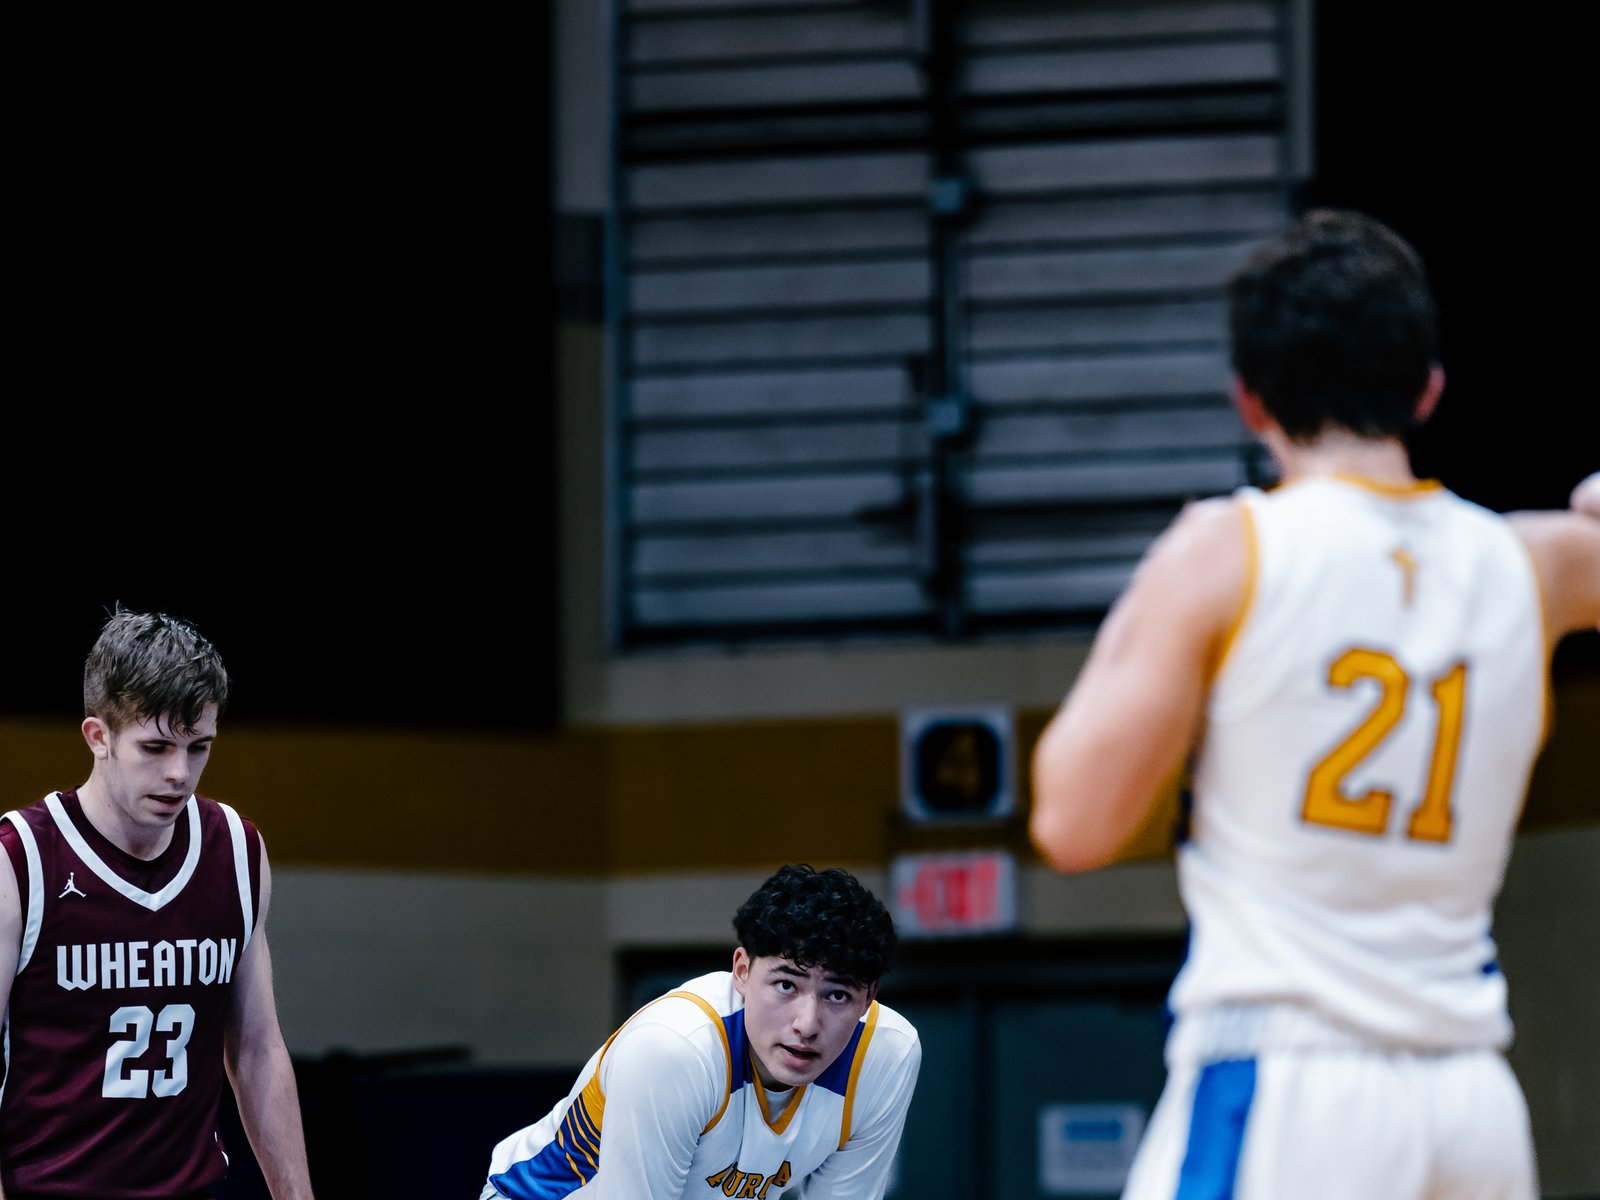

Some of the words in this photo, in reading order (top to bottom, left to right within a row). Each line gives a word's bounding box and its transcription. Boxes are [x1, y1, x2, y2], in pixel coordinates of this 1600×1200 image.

[1298, 646, 1468, 845] 21
[57, 938, 236, 991] WHEATON
[102, 1004, 196, 1099] 23
